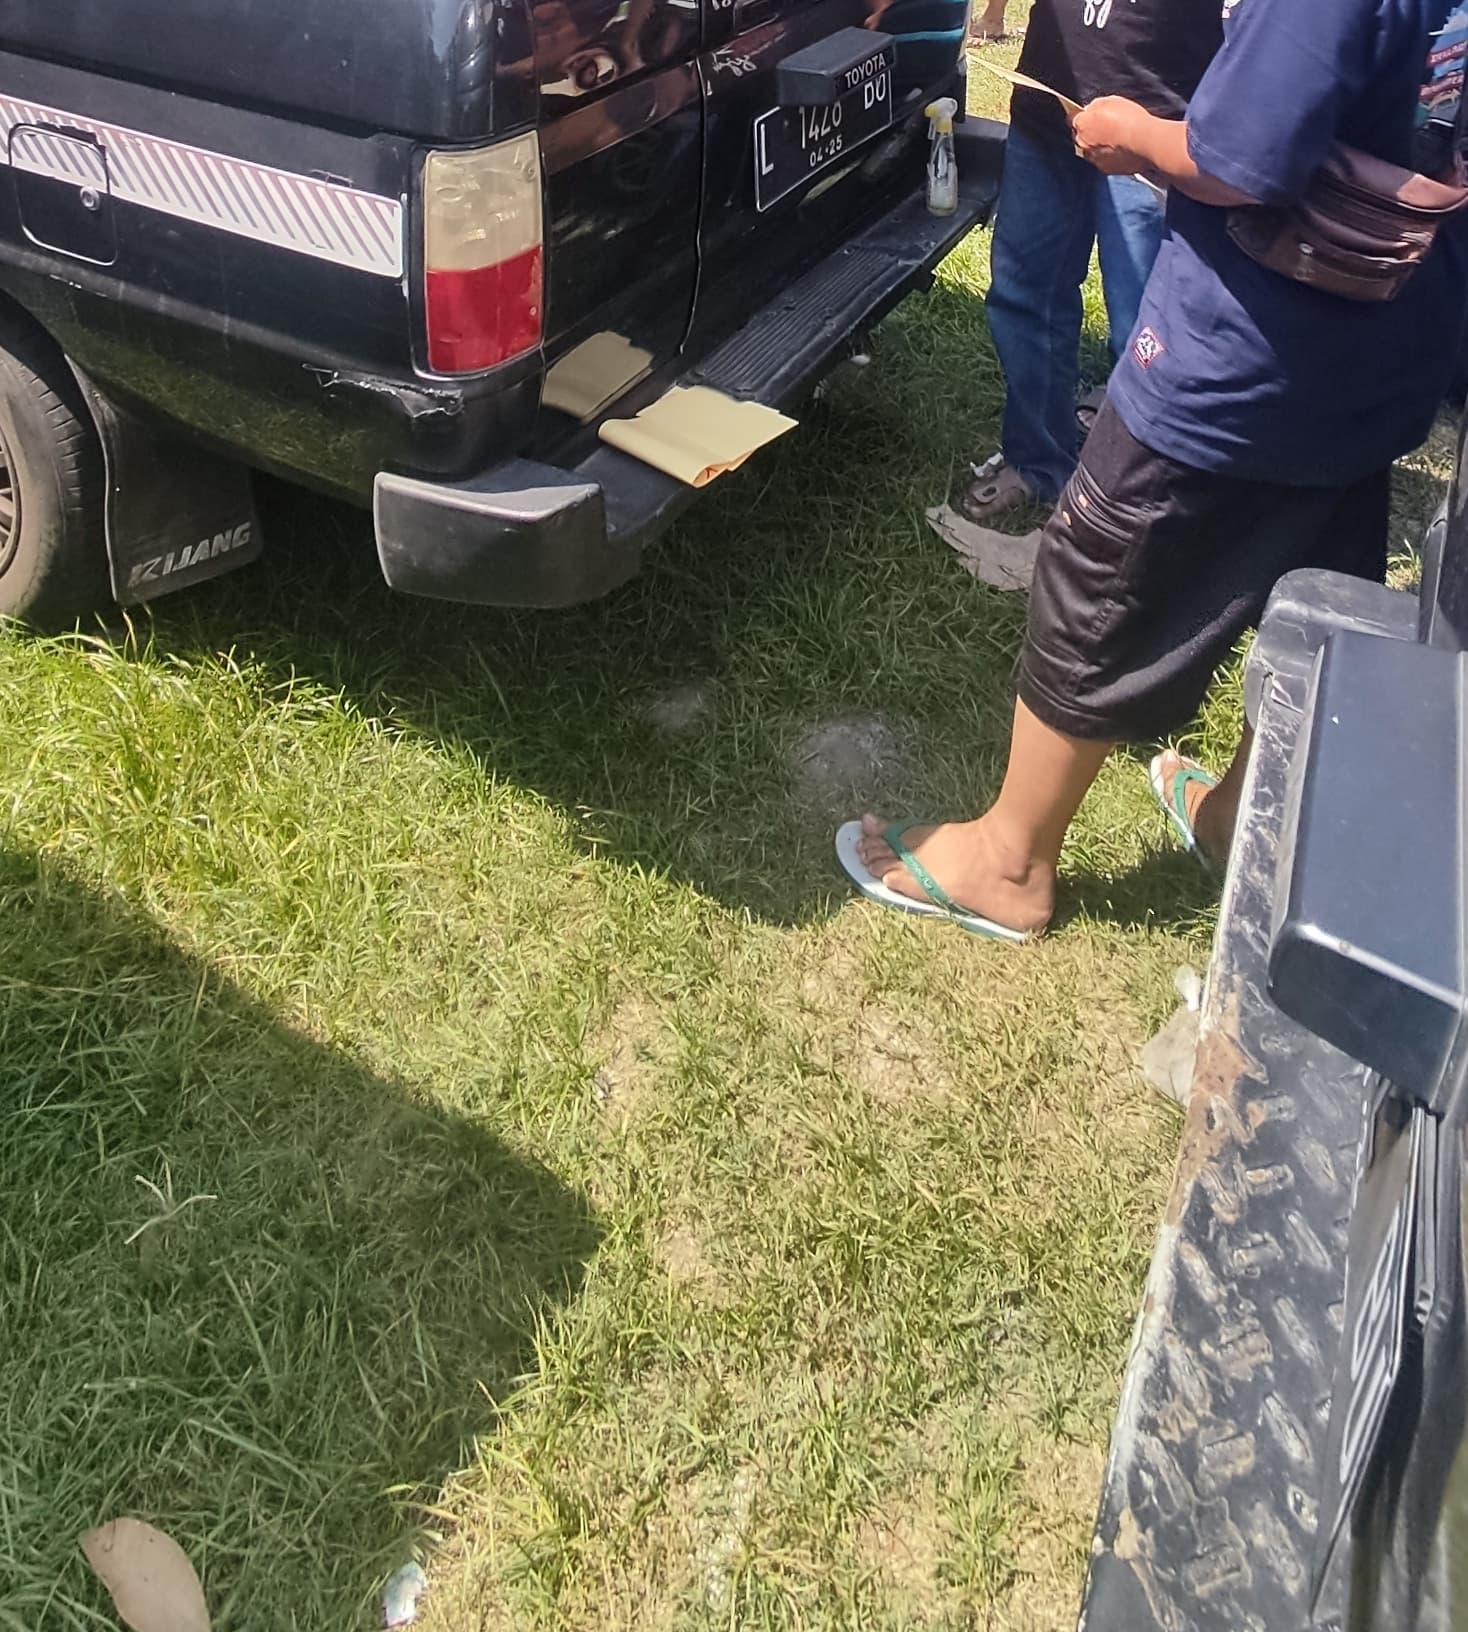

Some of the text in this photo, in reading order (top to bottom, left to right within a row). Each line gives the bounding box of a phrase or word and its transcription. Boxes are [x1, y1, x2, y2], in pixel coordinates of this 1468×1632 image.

[844, 52, 886, 89] TOYOTA
[761, 123, 775, 176] L
[127, 521, 251, 588] KIJANG
